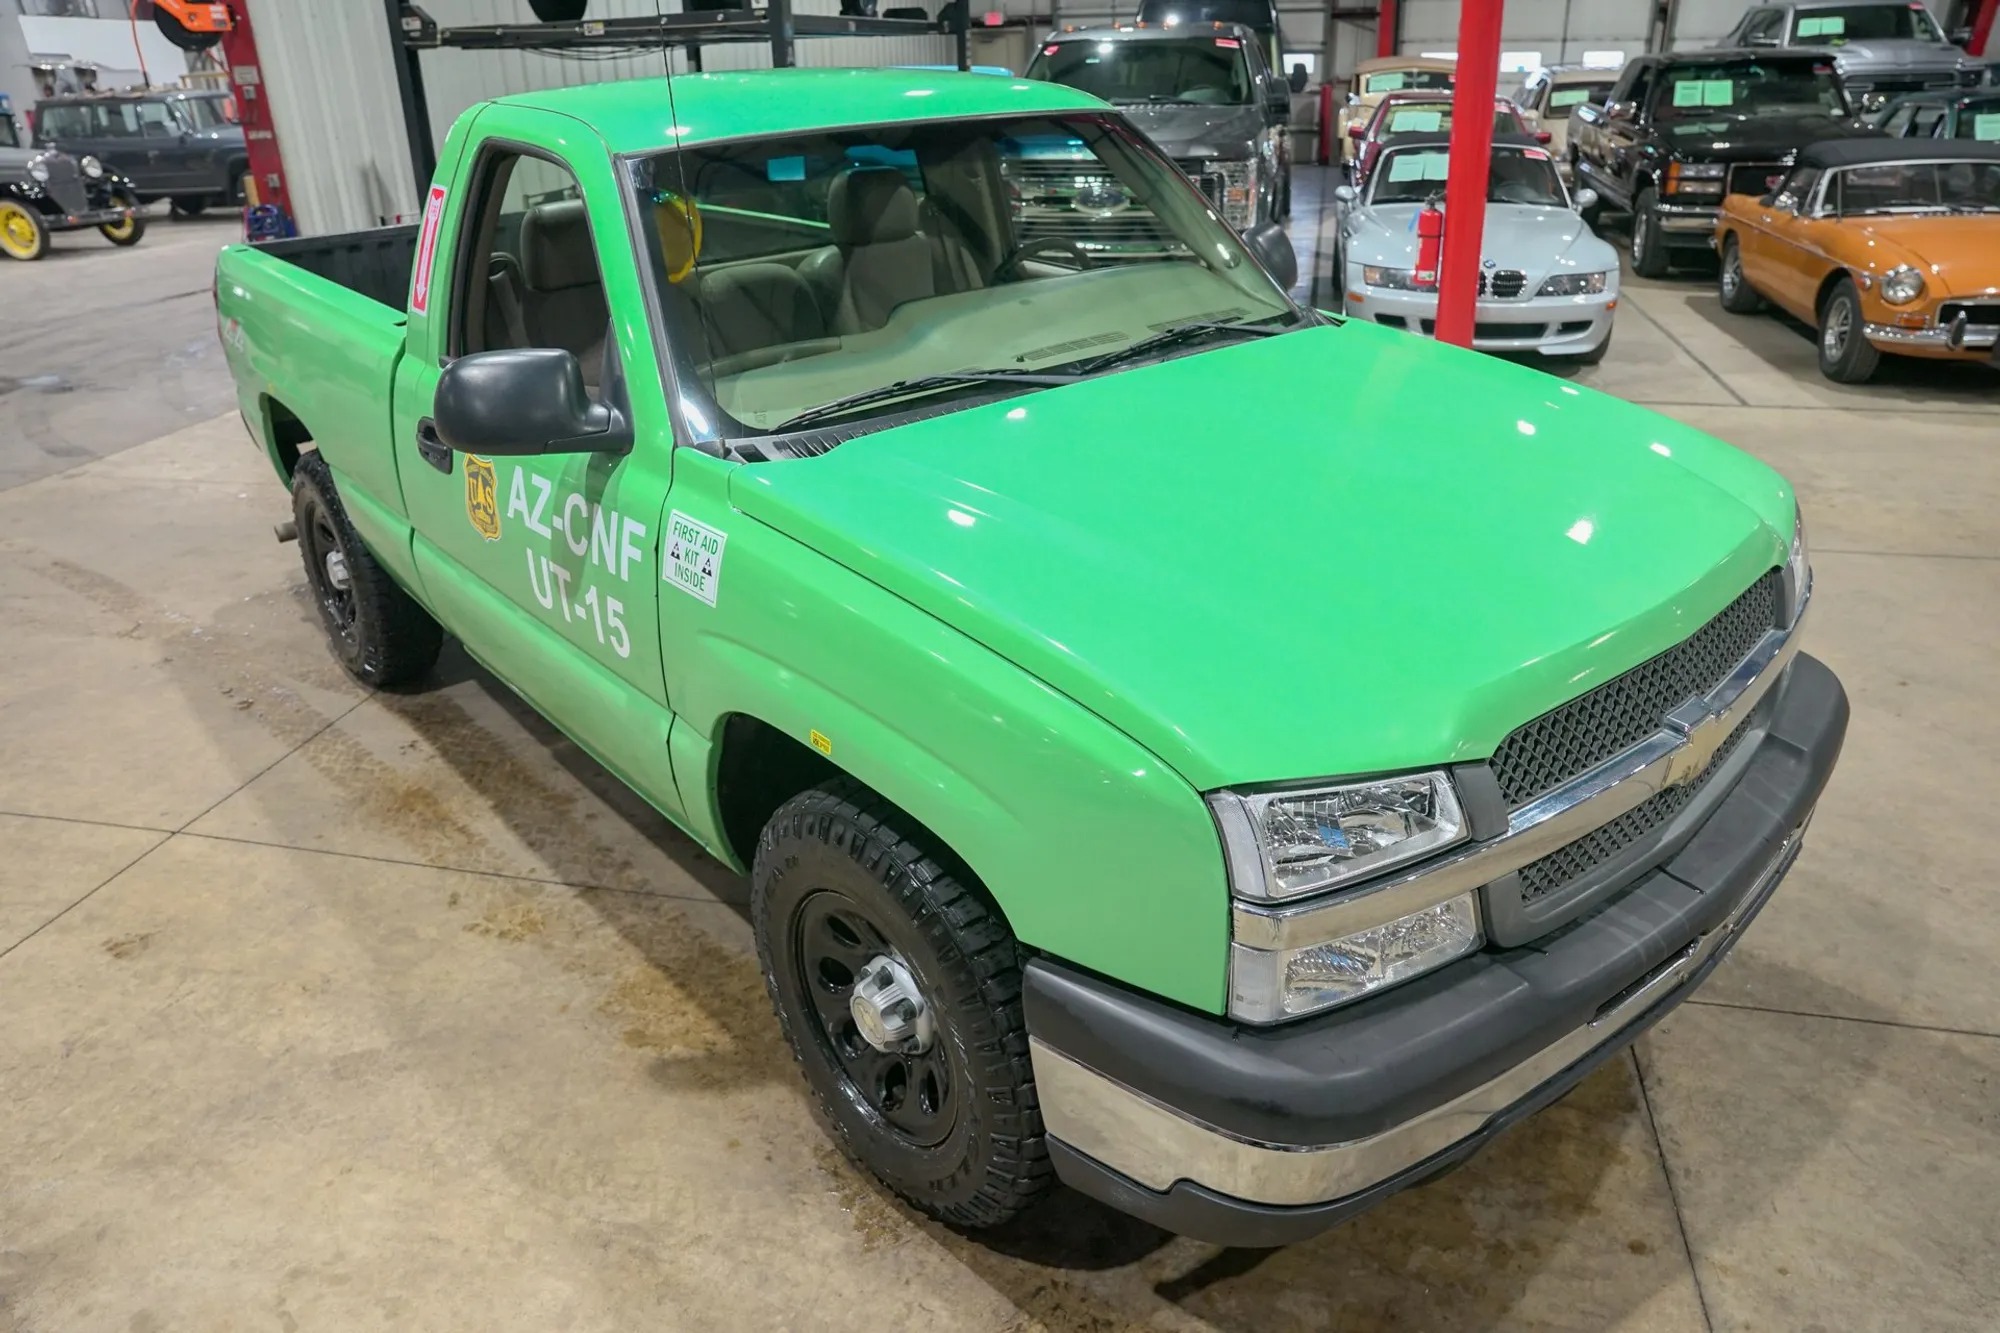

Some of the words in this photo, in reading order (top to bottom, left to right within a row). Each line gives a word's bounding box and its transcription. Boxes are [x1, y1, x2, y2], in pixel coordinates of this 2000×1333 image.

[507, 465, 646, 582] AZ-CNF
[673, 521, 700, 546] FIRST
[700, 535, 719, 555] AID
[684, 547, 699, 567] KIT
[674, 562, 705, 591] INSIDE
[526, 547, 631, 659] UT-15
